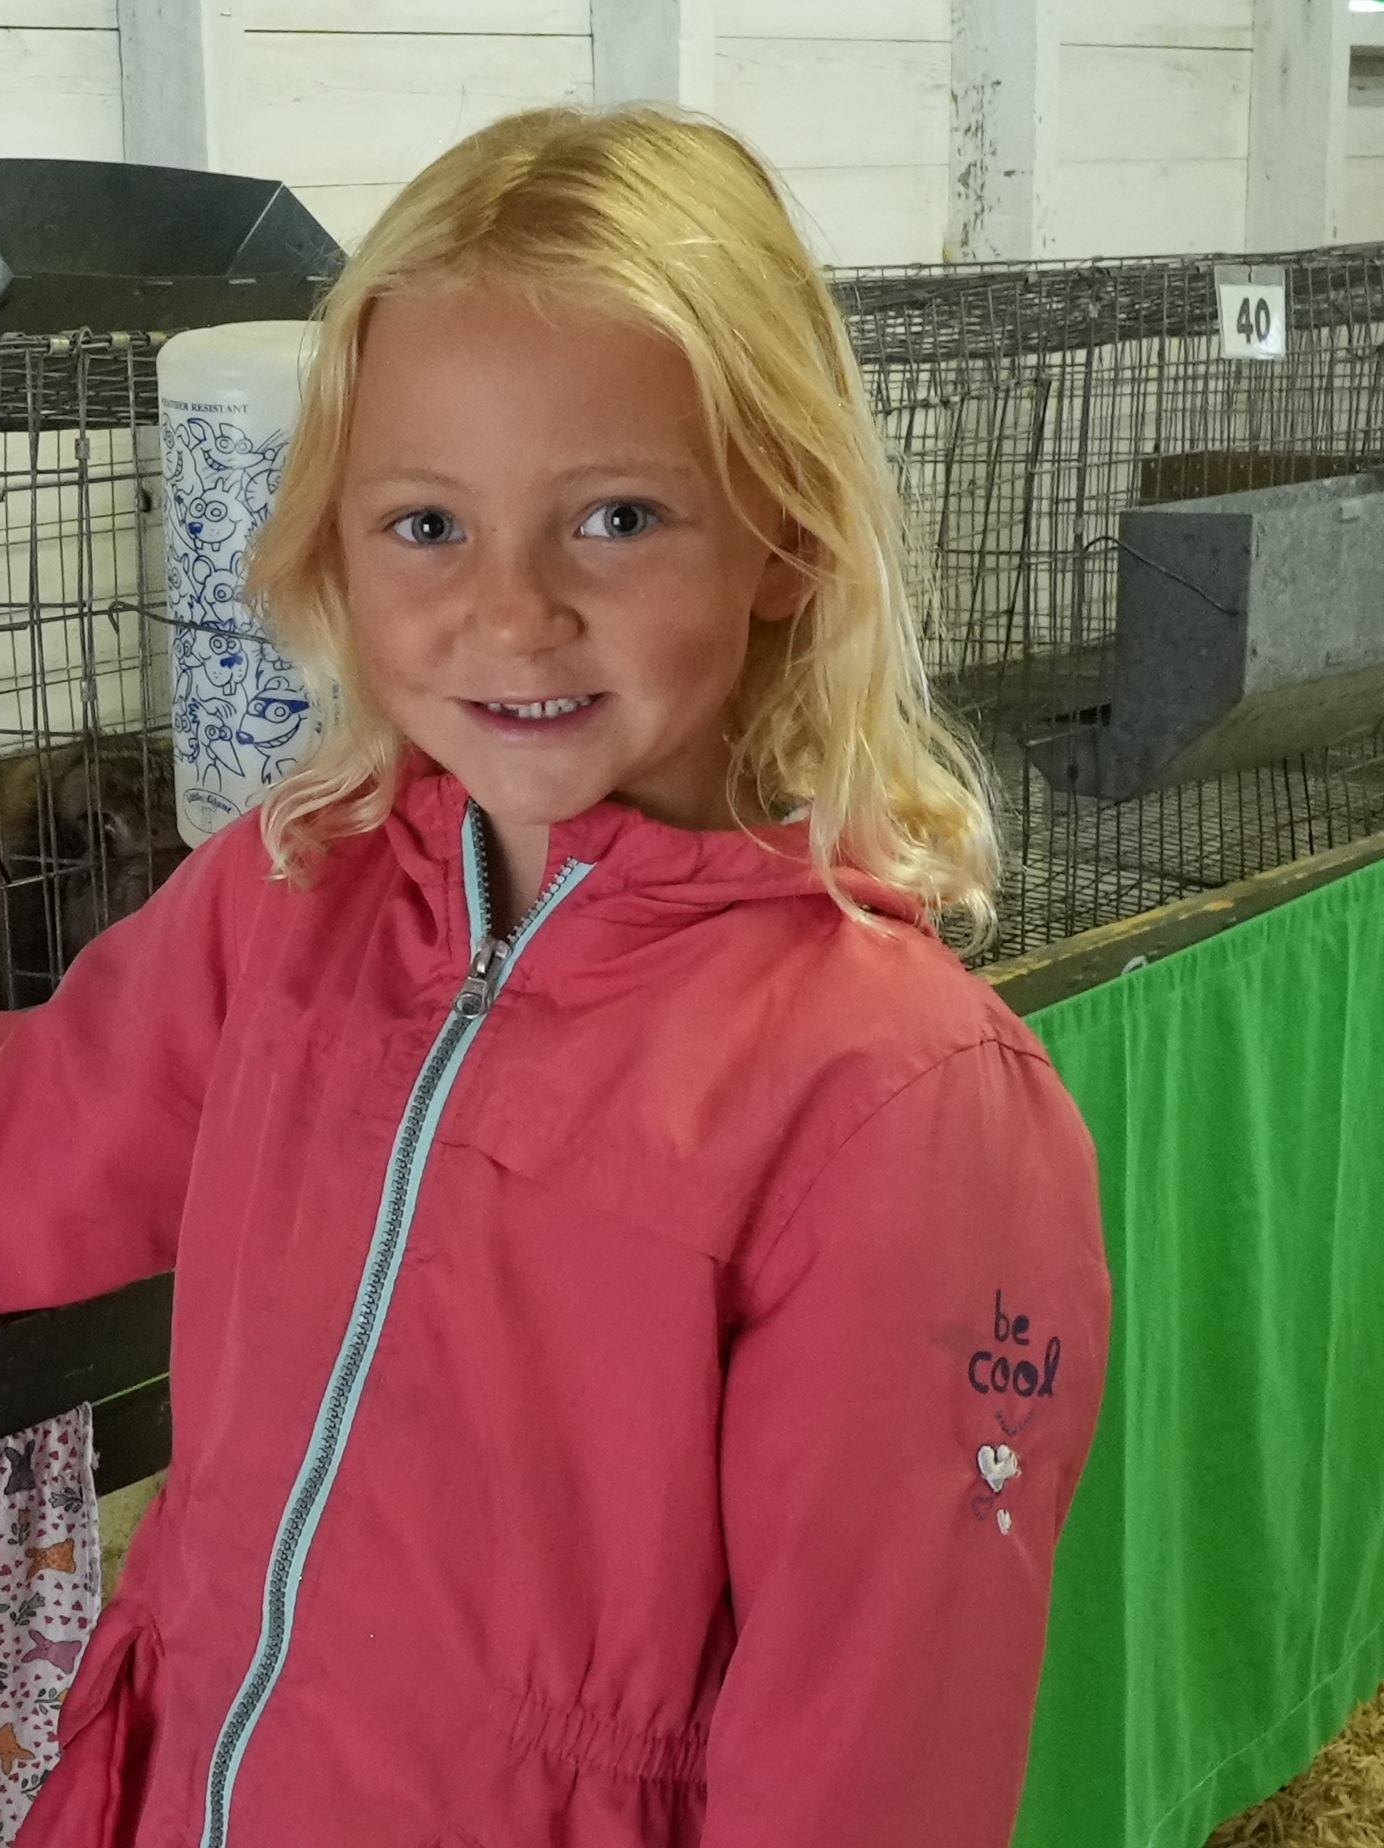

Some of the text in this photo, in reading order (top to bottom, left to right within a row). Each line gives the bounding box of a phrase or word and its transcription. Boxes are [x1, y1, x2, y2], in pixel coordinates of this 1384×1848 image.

[1236, 297, 1270, 344] 40
[191, 402, 248, 413] RESISTANT
[994, 1289, 1030, 1345] be
[968, 1336, 1061, 1397] cool
